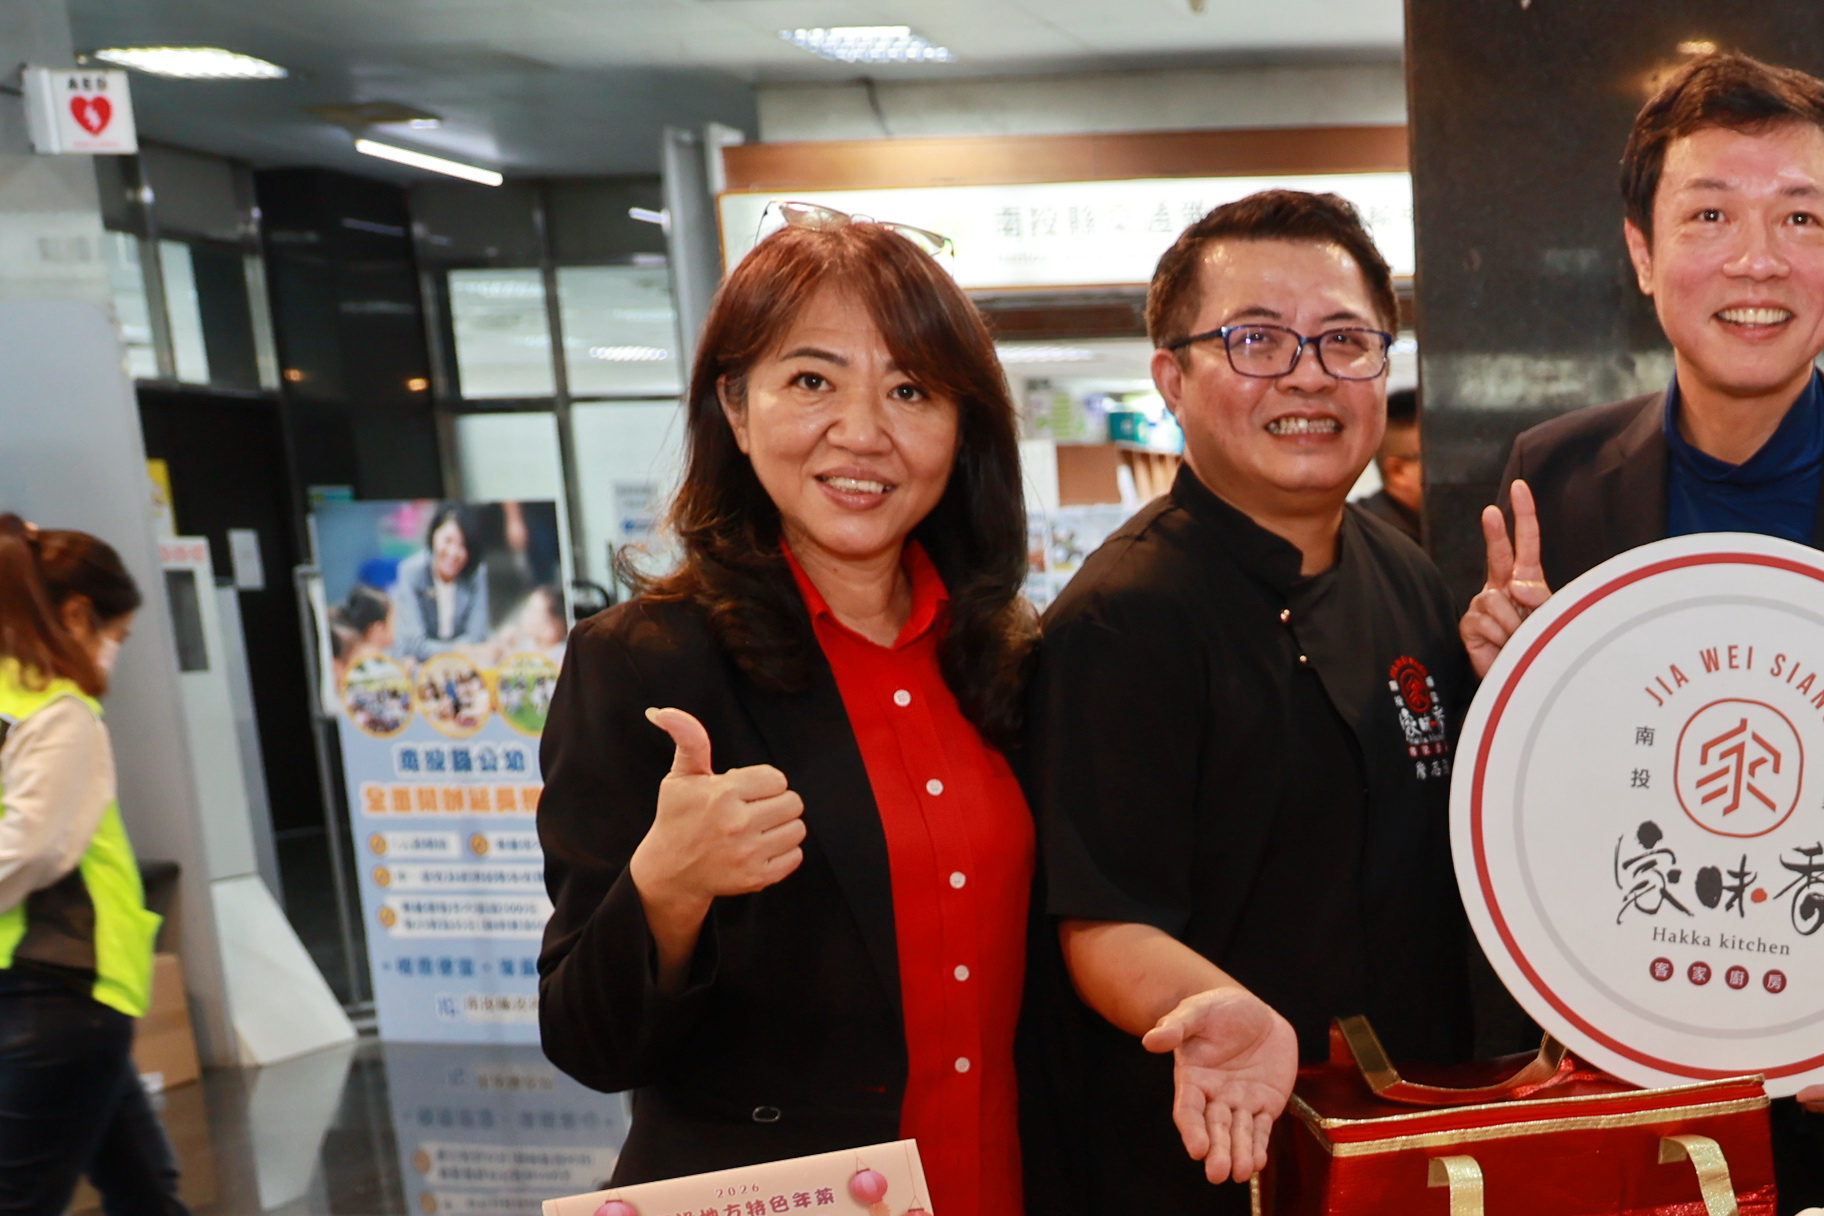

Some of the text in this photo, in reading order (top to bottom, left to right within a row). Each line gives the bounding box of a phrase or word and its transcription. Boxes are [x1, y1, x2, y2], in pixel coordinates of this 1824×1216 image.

[68, 77, 107, 91] AED
[1644, 663, 1690, 707] JIA
[1700, 645, 1753, 673] WEI
[1630, 725, 1655, 790] 南投
[1652, 926, 1791, 956] Hakka kitchen
[1652, 959, 1785, 992] 客家廚房
[715, 1183, 760, 1199] 2026
